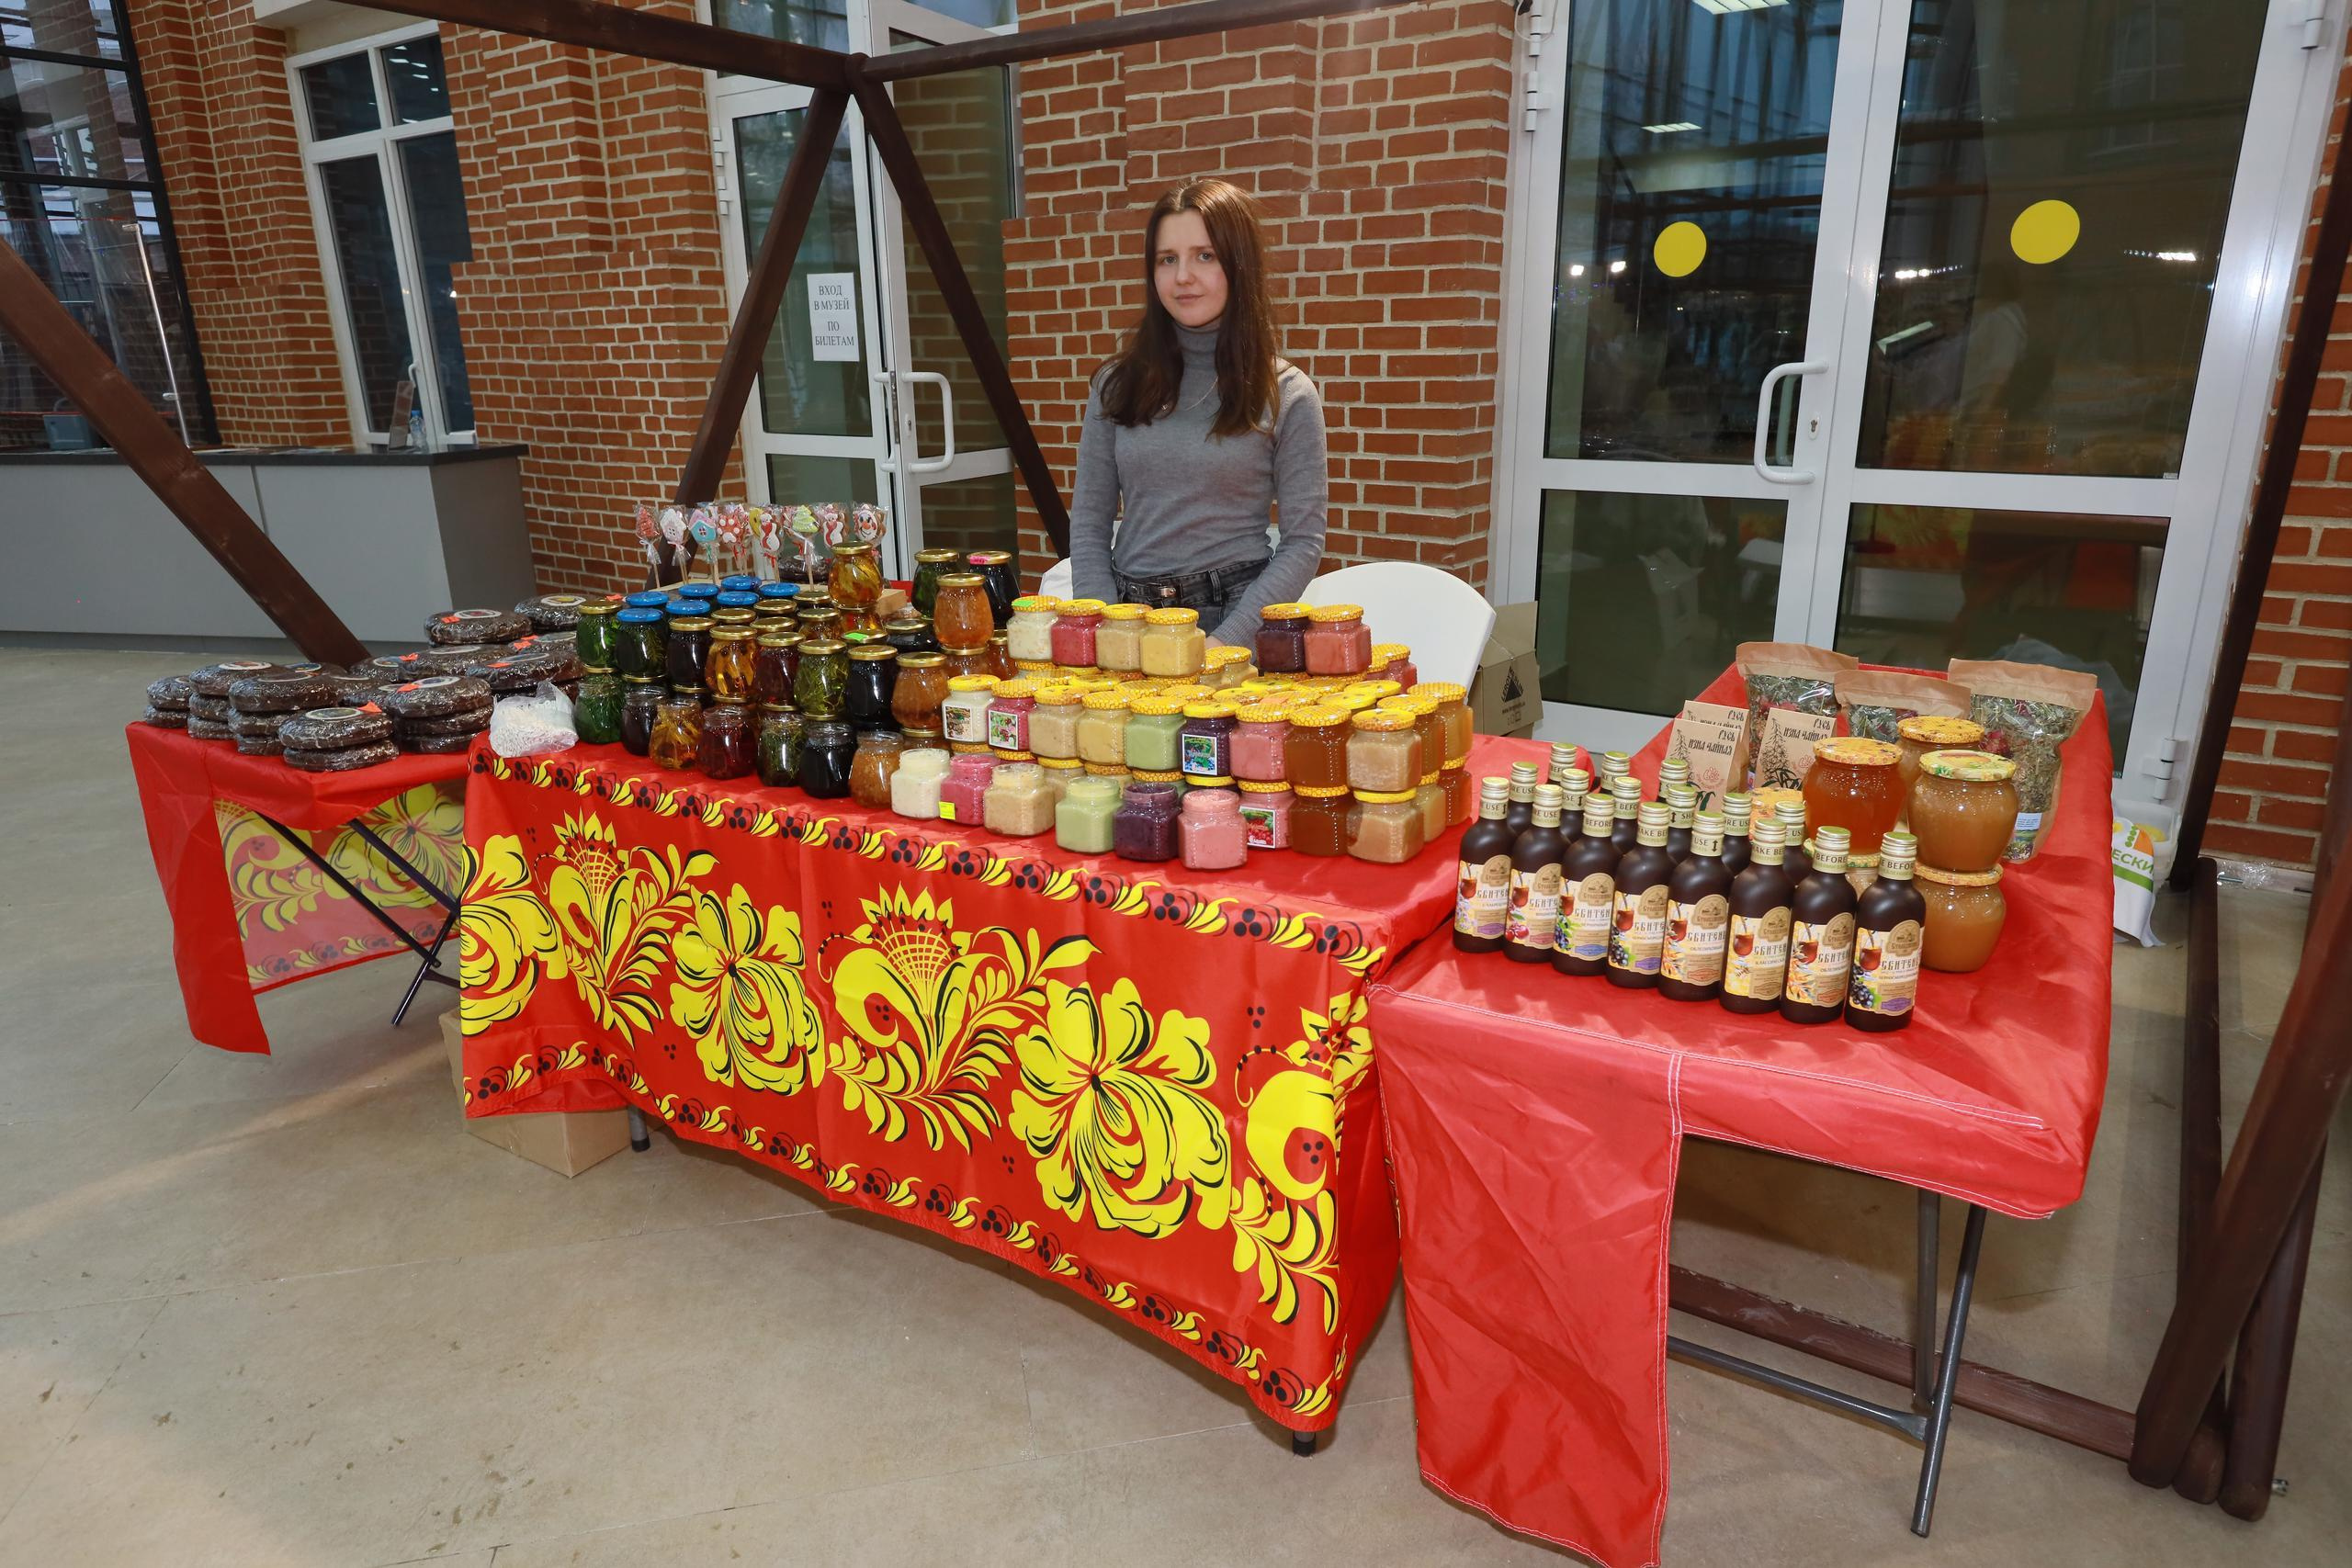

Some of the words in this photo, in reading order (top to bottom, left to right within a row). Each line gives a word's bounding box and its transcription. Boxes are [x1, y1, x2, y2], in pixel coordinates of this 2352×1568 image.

[819, 285, 842, 296] ВХОД
[814, 300, 820, 310] В
[821, 298, 850, 310] МУЗЕЙ
[827, 321, 840, 332] ПО
[815, 335, 854, 346] БИЛЕТАМ
[1718, 729, 1736, 742] РУСЬ
[1486, 803, 1500, 811] USE
[1544, 810, 1557, 818] USE
[1585, 818, 1613, 828] BEFORE
[1693, 836, 1709, 847] USE
[1815, 852, 1848, 863] BEFORE
[2112, 849, 2154, 875] ЕСКИ
